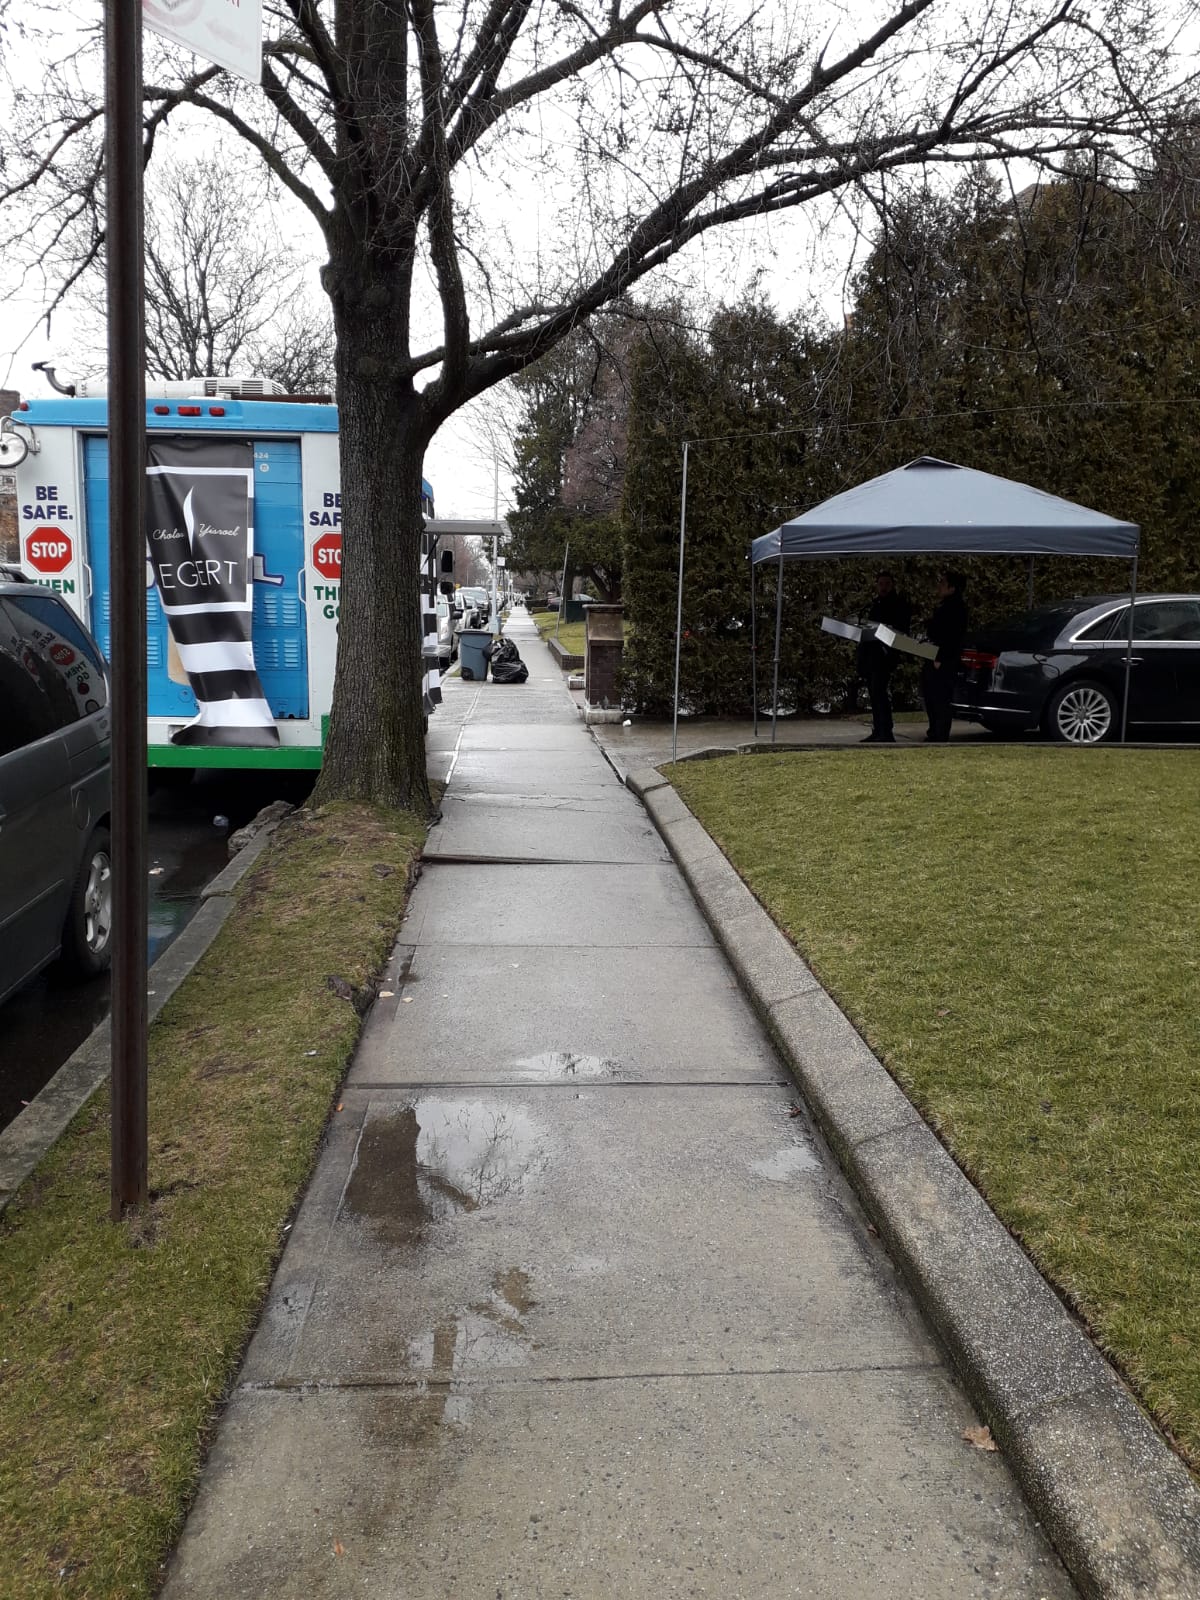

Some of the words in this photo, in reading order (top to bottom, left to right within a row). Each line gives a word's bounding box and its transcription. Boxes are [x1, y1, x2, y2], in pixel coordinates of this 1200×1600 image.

[35, 485, 58, 501] BE
[22, 505, 73, 520] SAFE.
[309, 511, 342, 527] SAF
[31, 542, 67, 558] STOP
[318, 548, 342, 564] STO
[159, 559, 238, 589] EGERT
